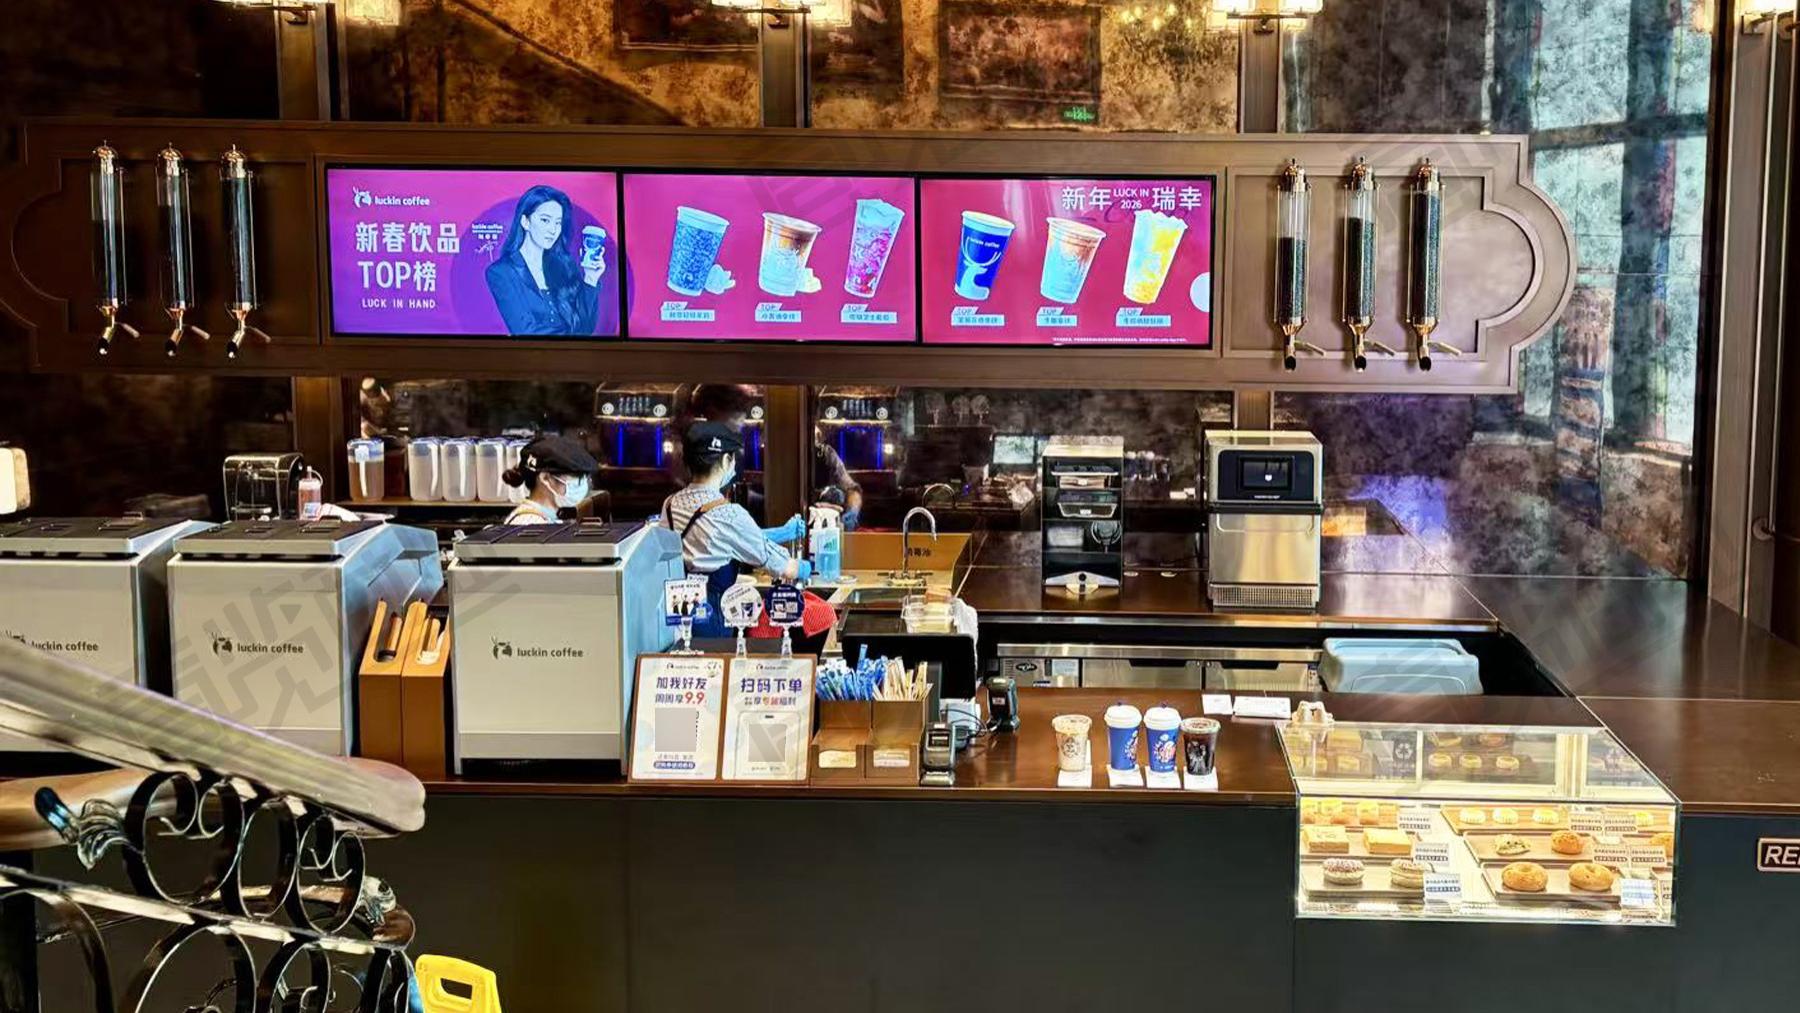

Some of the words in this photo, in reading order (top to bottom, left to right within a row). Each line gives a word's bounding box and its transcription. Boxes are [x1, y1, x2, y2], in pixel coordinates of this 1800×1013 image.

[1062, 186, 1112, 211] 新年
[1113, 188, 1138, 198] LUCK
[1140, 188, 1150, 198] IN
[1152, 186, 1202, 211] 瑞幸
[374, 195, 401, 206] luckin
[402, 196, 430, 206] coffee
[1120, 200, 1143, 209] 2026
[356, 222, 460, 253] 新春饮品
[357, 260, 437, 293] TOP榜
[362, 298, 387, 309] LUCK
[393, 299, 403, 309] IN
[408, 299, 436, 309] HAND
[65, 641, 99, 652] coffee
[237, 642, 269, 653] luckin
[271, 642, 304, 654] coffee
[517, 647, 549, 657] luckin
[550, 647, 584, 658] coffee
[656, 676, 708, 690] 加我好友
[740, 677, 803, 693] 扫码下单
[1764, 845, 1800, 865] RE
